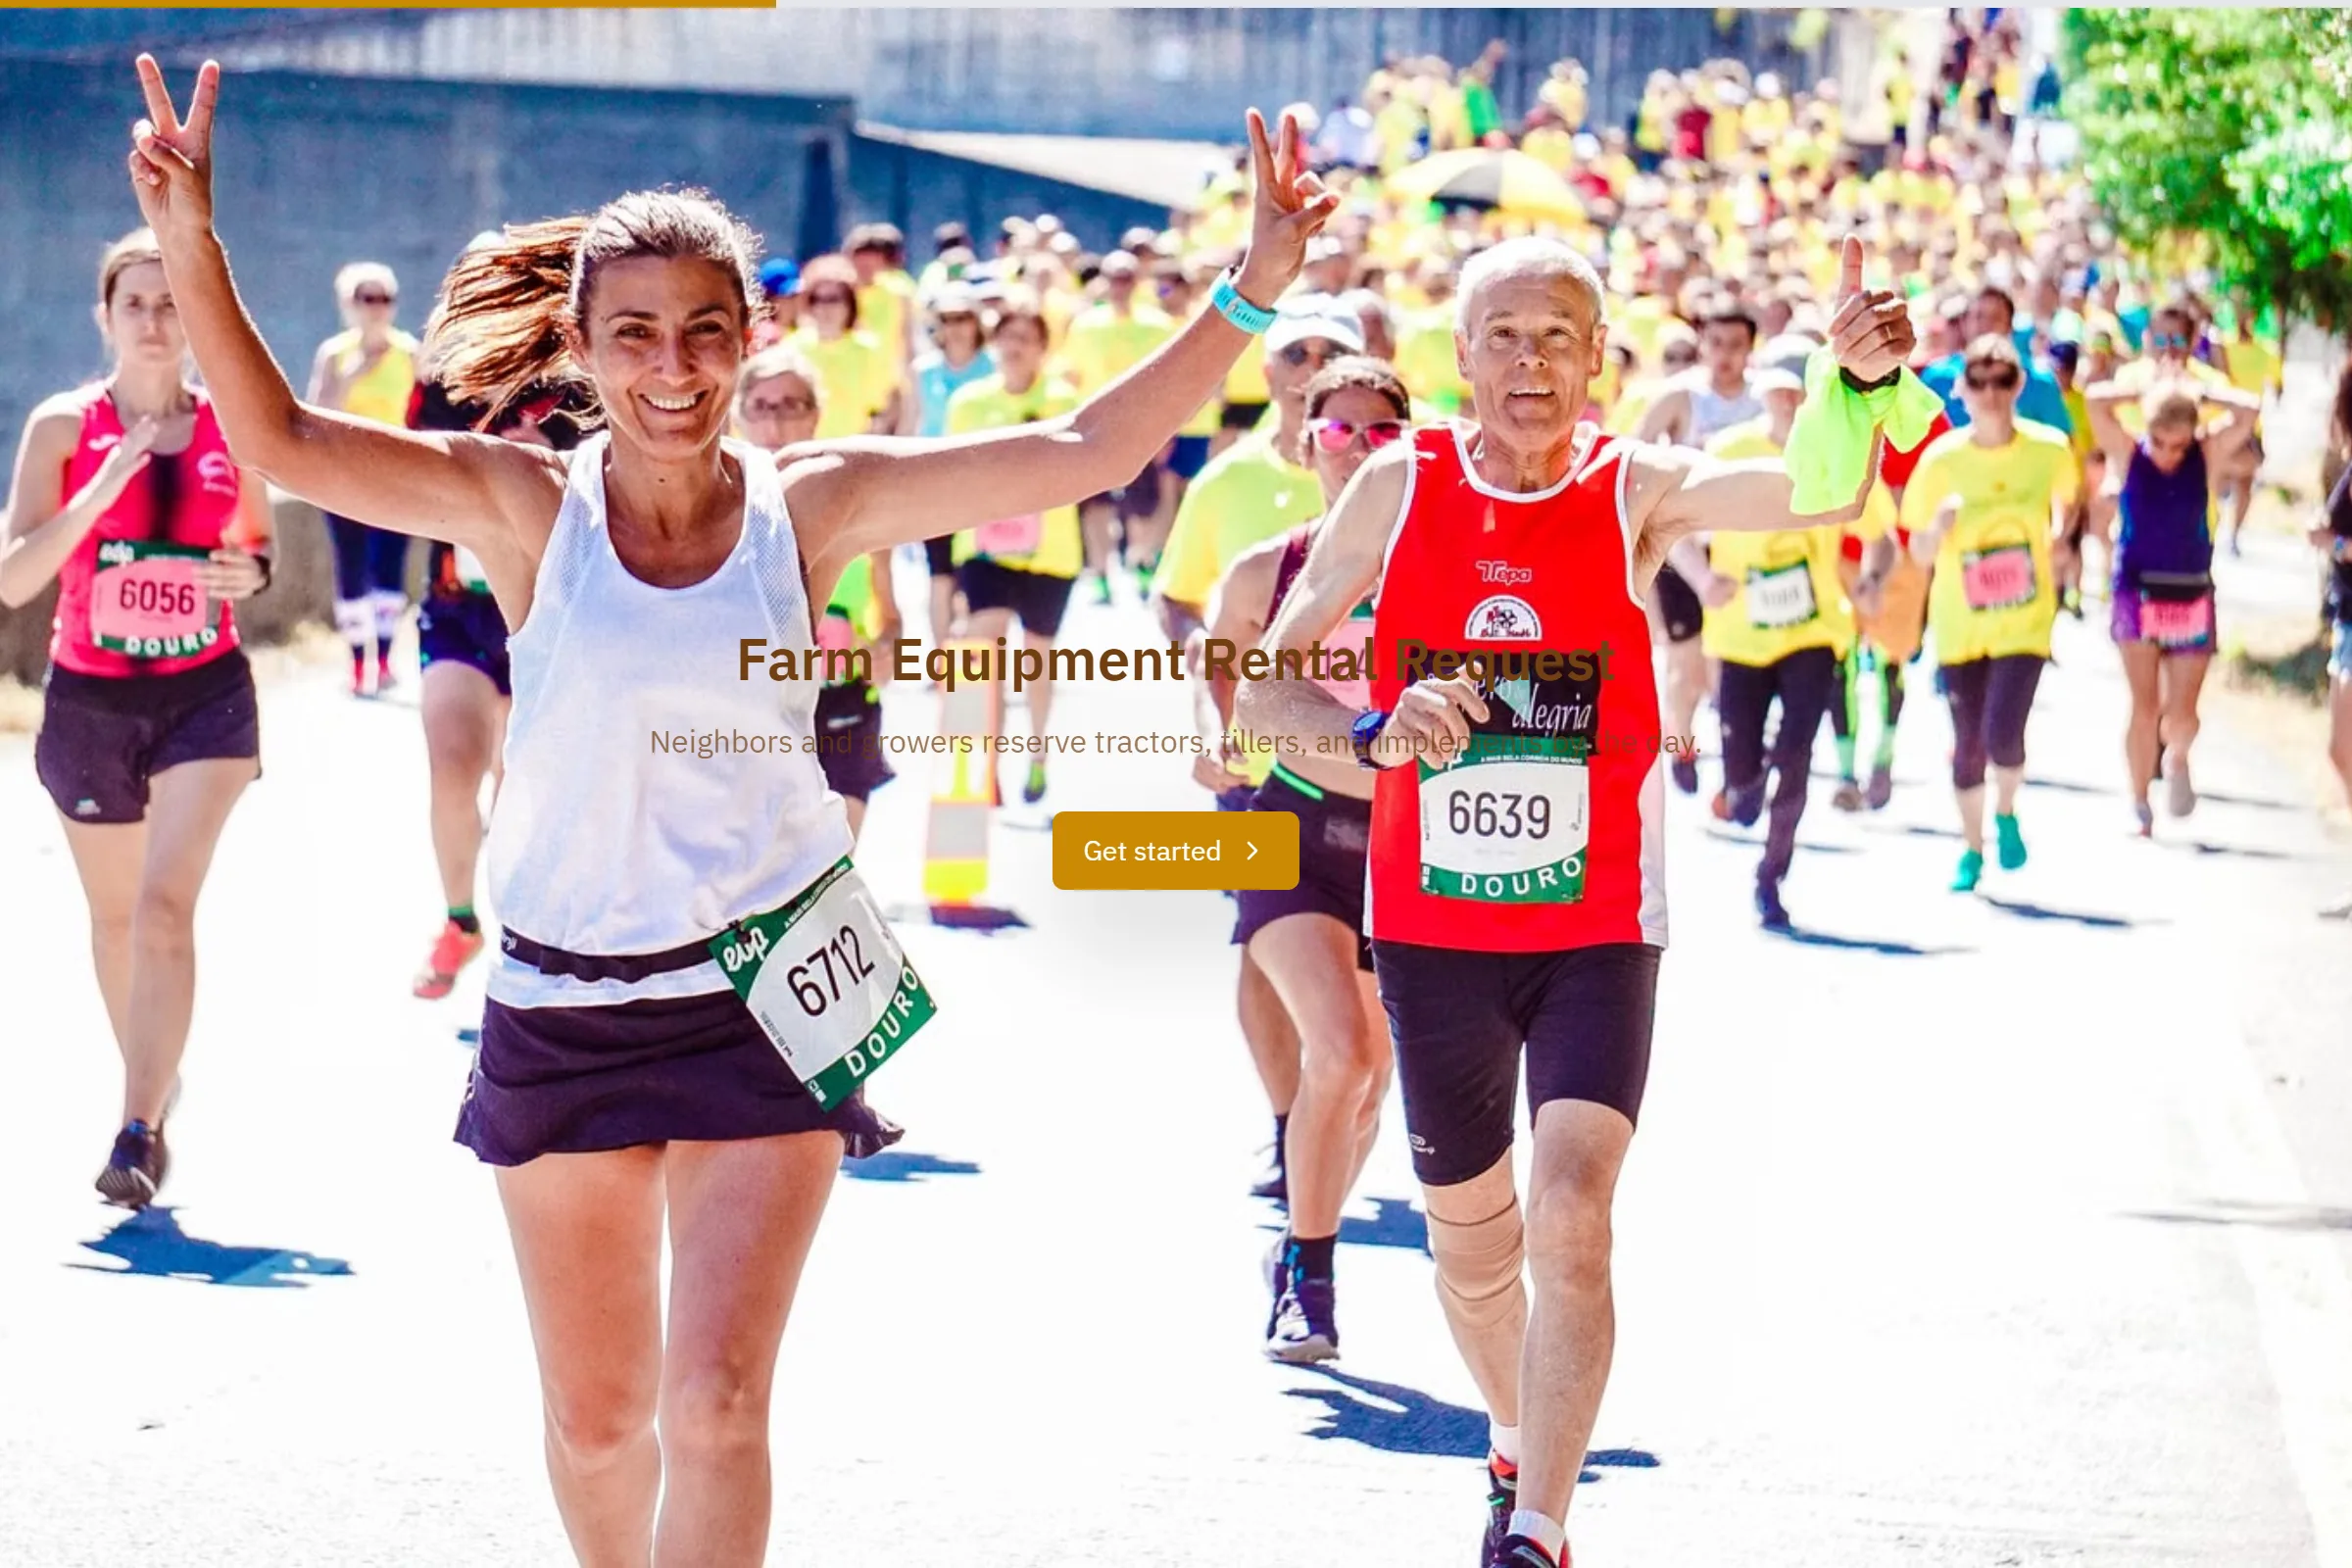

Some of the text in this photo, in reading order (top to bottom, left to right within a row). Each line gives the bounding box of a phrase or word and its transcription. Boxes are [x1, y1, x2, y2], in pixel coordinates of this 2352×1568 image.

[120, 578, 195, 615] 6056
[124, 626, 218, 657] DOURO
[1512, 682, 1592, 738] alegria
[1449, 790, 1551, 840] 6639
[1461, 857, 1581, 897] DOURO
[787, 925, 875, 1017] 6712
[844, 965, 919, 1077] DOURO
